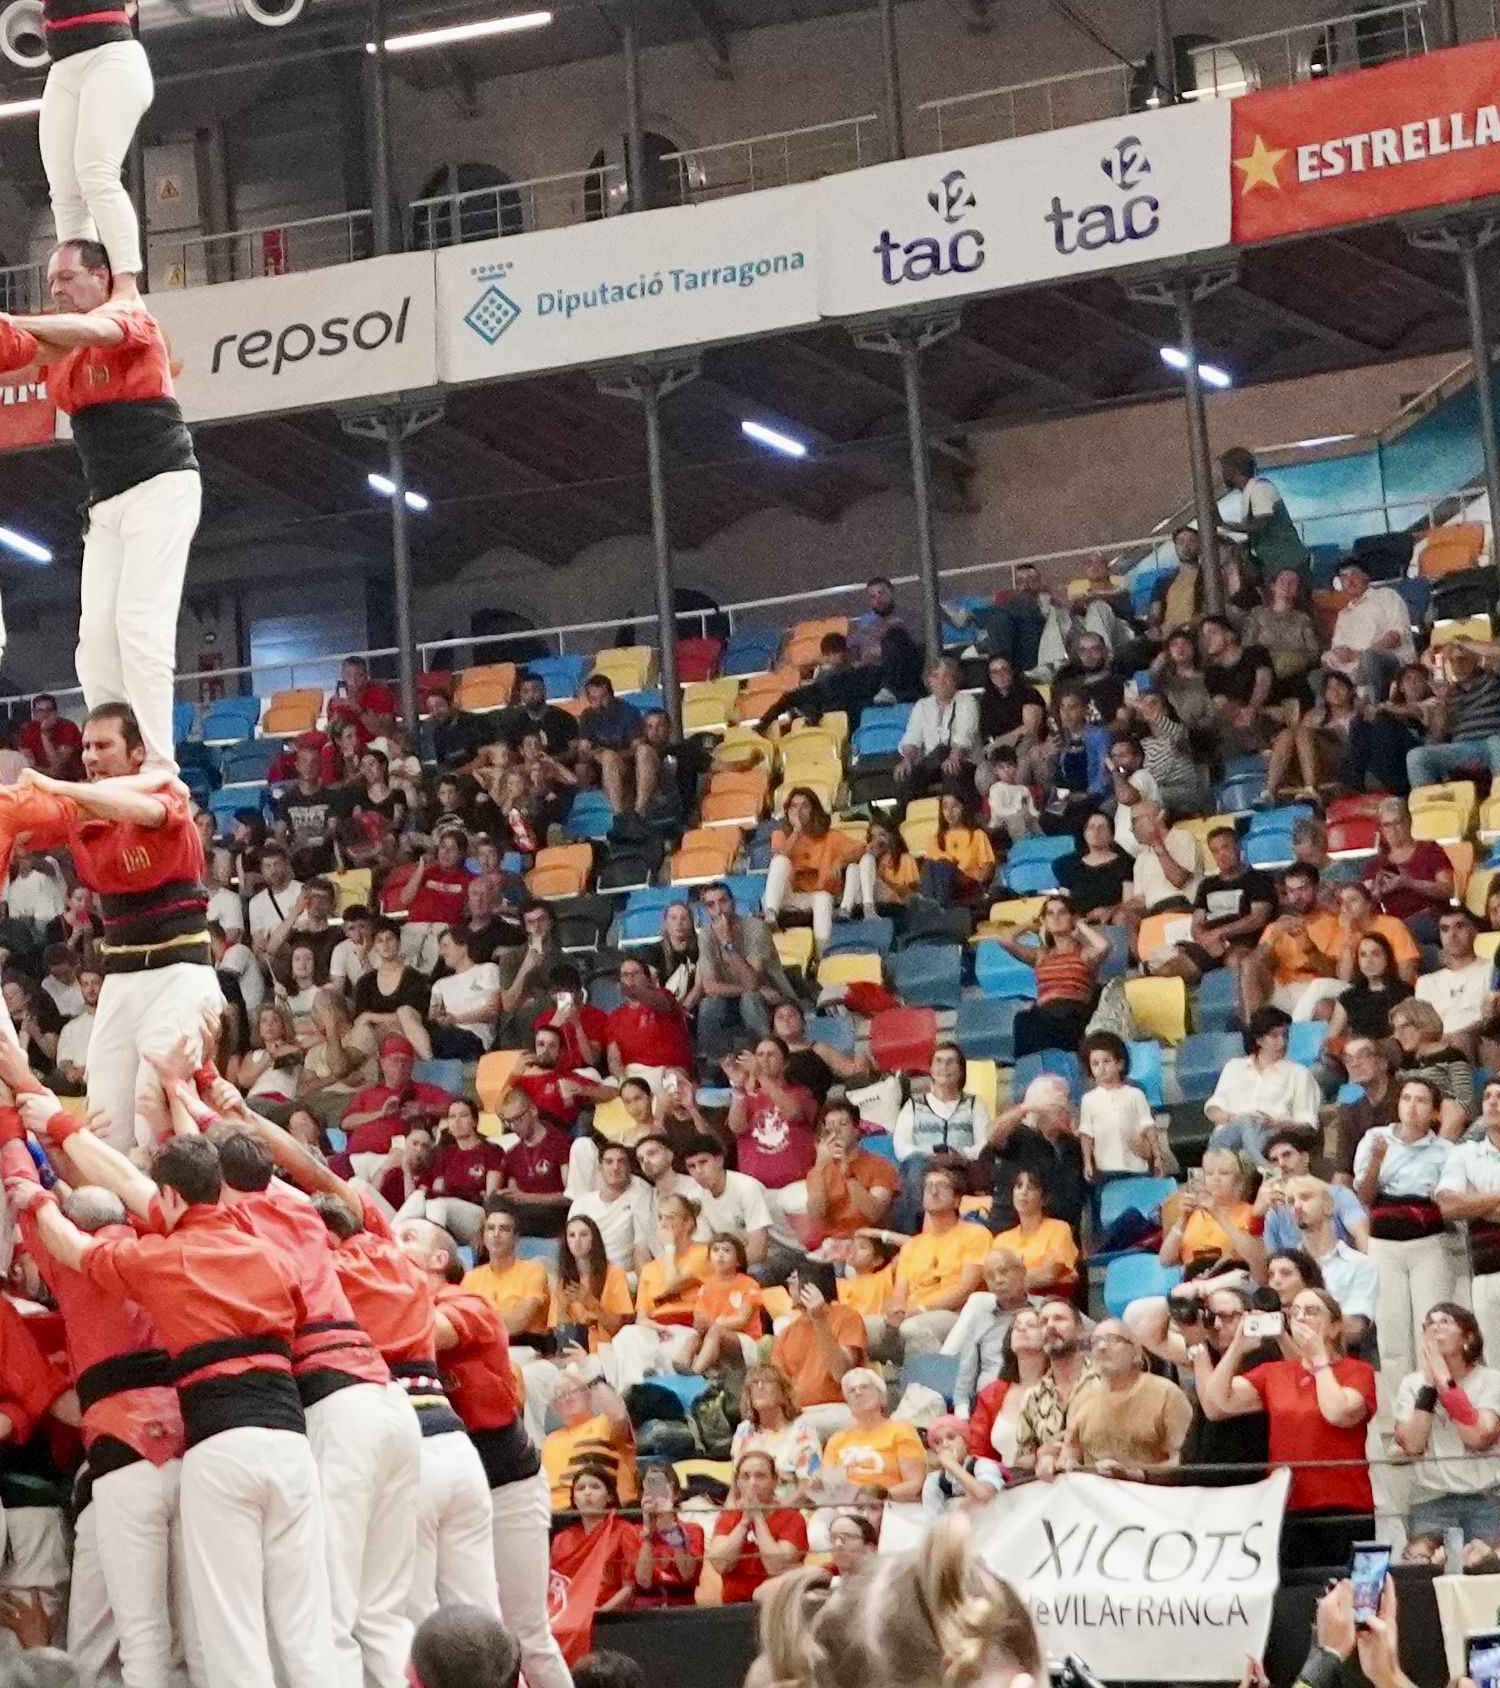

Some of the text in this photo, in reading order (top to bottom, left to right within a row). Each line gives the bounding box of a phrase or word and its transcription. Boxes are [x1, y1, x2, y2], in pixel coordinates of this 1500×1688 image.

[874, 226, 985, 287] tac
[1045, 193, 1160, 255] tac
[537, 248, 806, 326] Diputació Tarragona
[211, 297, 409, 376] repsol
[1027, 1517, 1263, 1583] XICOTS
